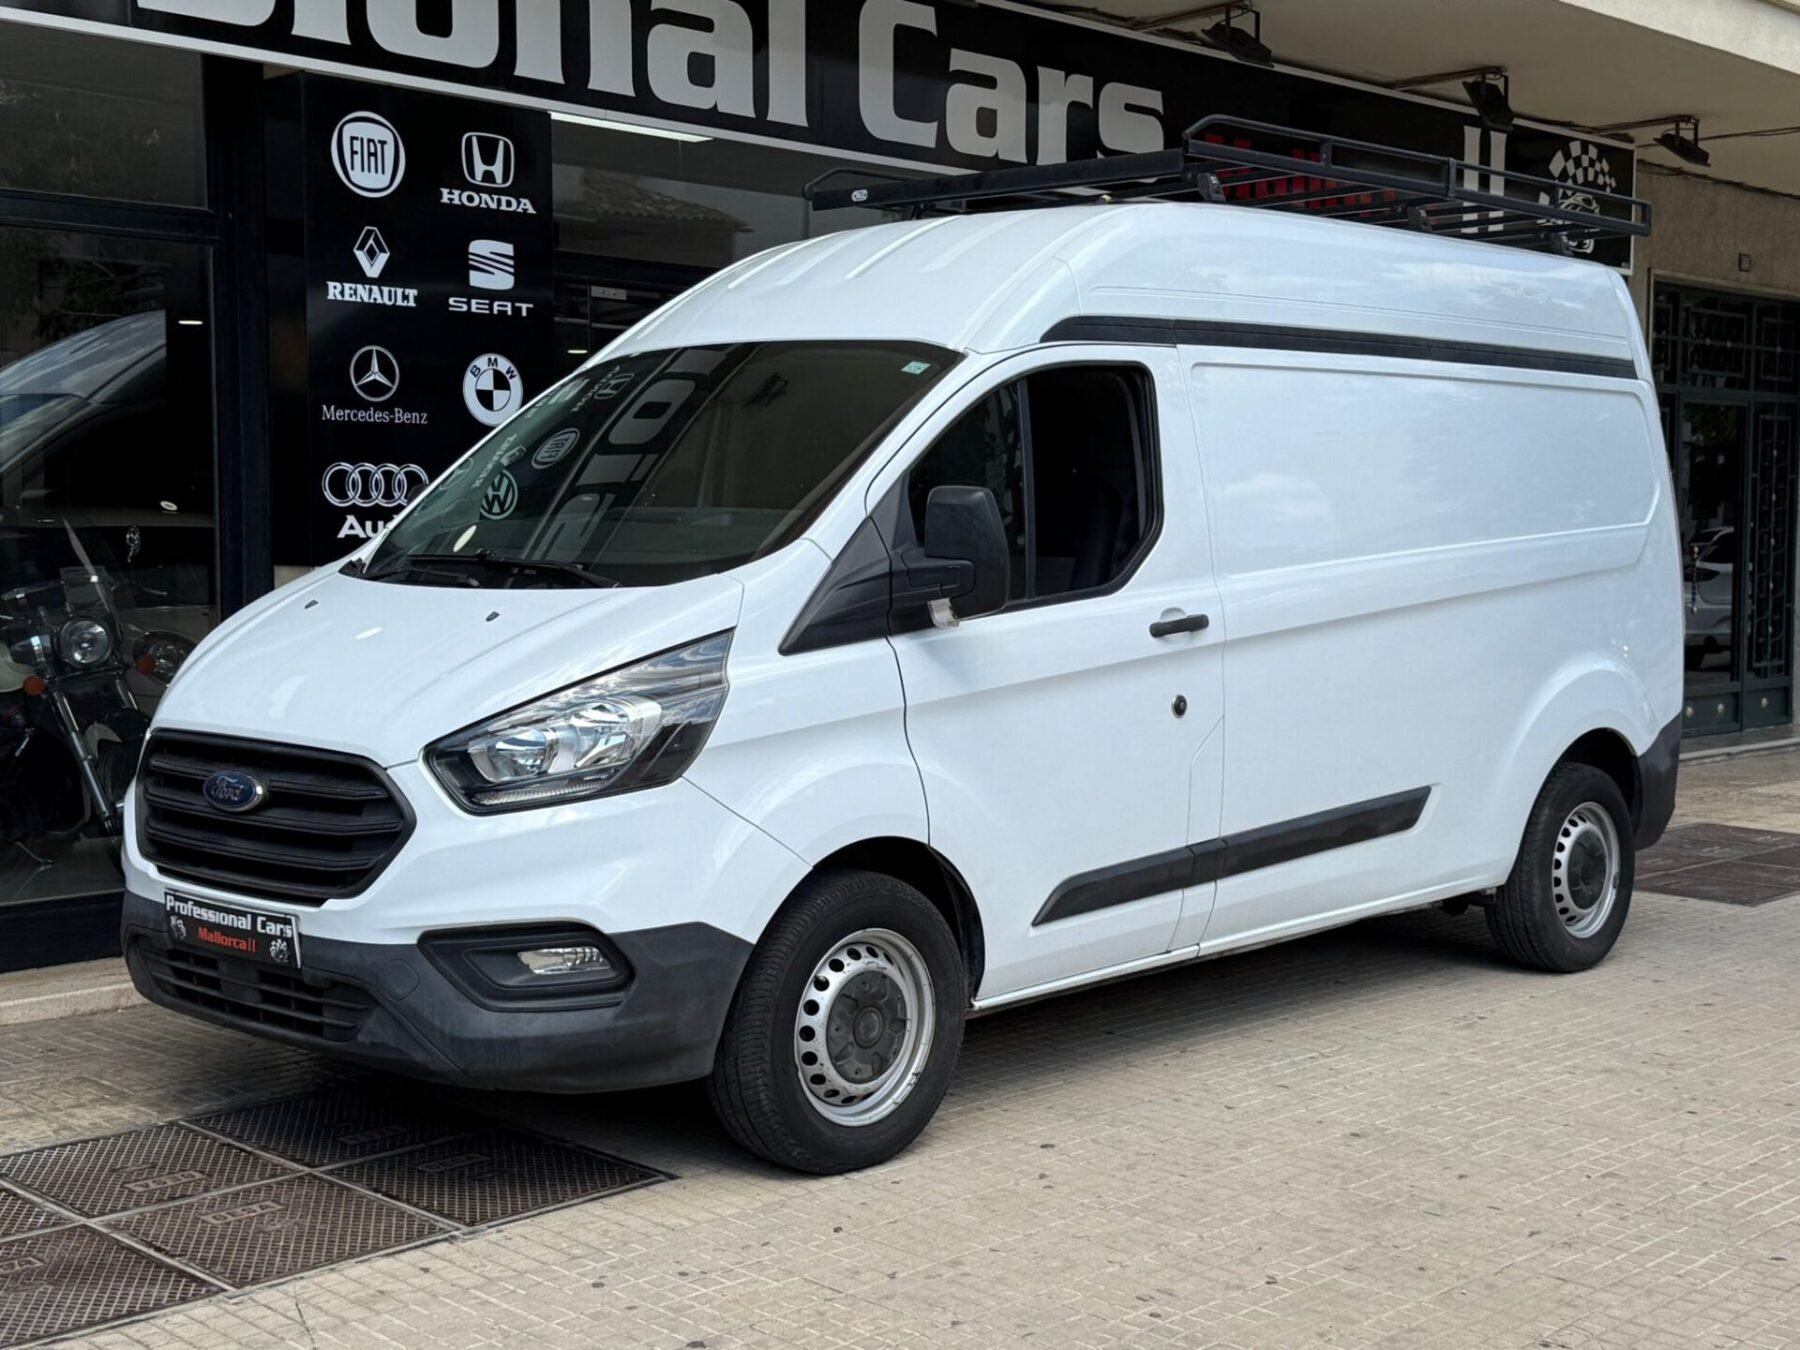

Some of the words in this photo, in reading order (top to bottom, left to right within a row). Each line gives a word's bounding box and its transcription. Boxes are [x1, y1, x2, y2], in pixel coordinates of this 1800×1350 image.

[858, 0, 1165, 182] Cars
[350, 135, 388, 176] FIAT
[440, 187, 537, 214] HONDA
[326, 281, 418, 307] RENAULT
[448, 297, 534, 317] SEAT
[469, 357, 517, 380] BMW
[321, 404, 428, 424] Mercedes-Benz
[337, 514, 402, 538] Au
[211, 776, 244, 801] Ford
[166, 895, 252, 930] Professional
[257, 916, 293, 938] Cars
[198, 927, 247, 951] Mallorca
